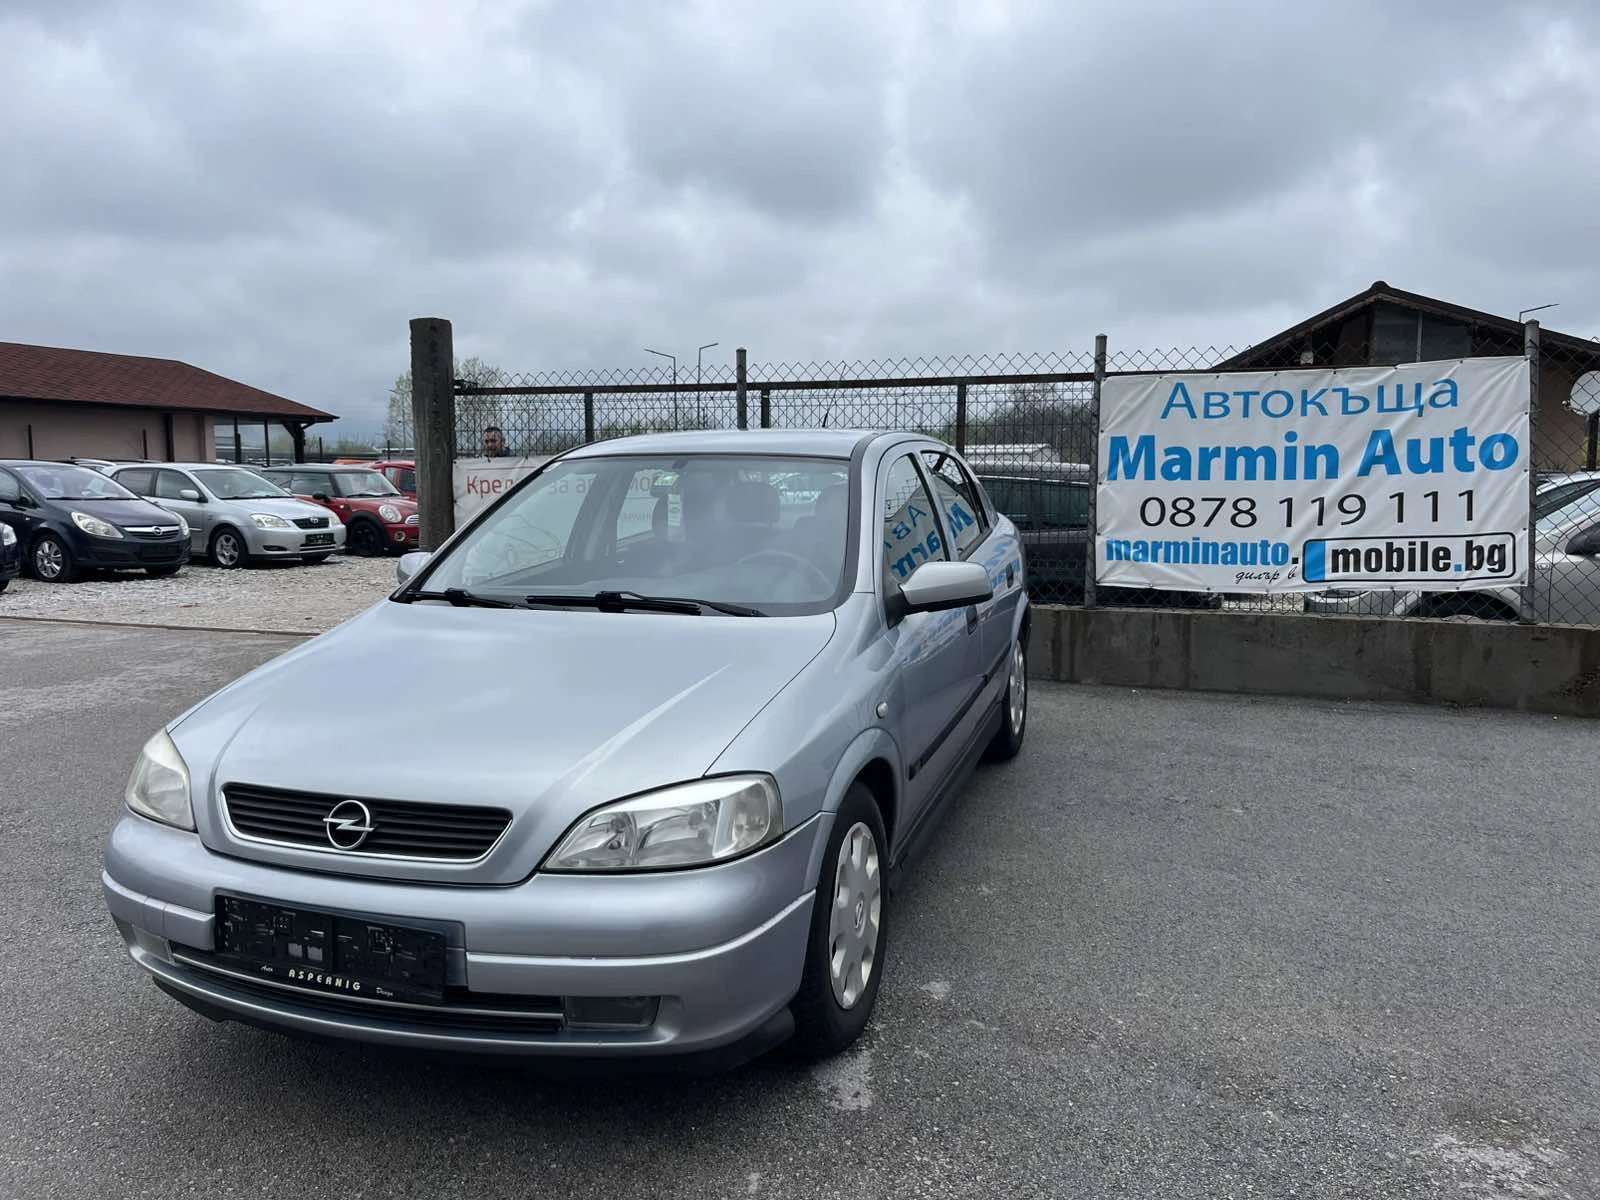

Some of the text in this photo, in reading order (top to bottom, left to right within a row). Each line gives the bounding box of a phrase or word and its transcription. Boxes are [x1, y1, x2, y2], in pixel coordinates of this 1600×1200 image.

[1160, 377, 1460, 420] Автокъща
[1106, 426, 1521, 483] Marmin Auto
[1139, 489, 1475, 529] 0878 119 111
[1330, 540, 1508, 575] mobile.bg
[288, 968, 361, 991] ASPERNIG
